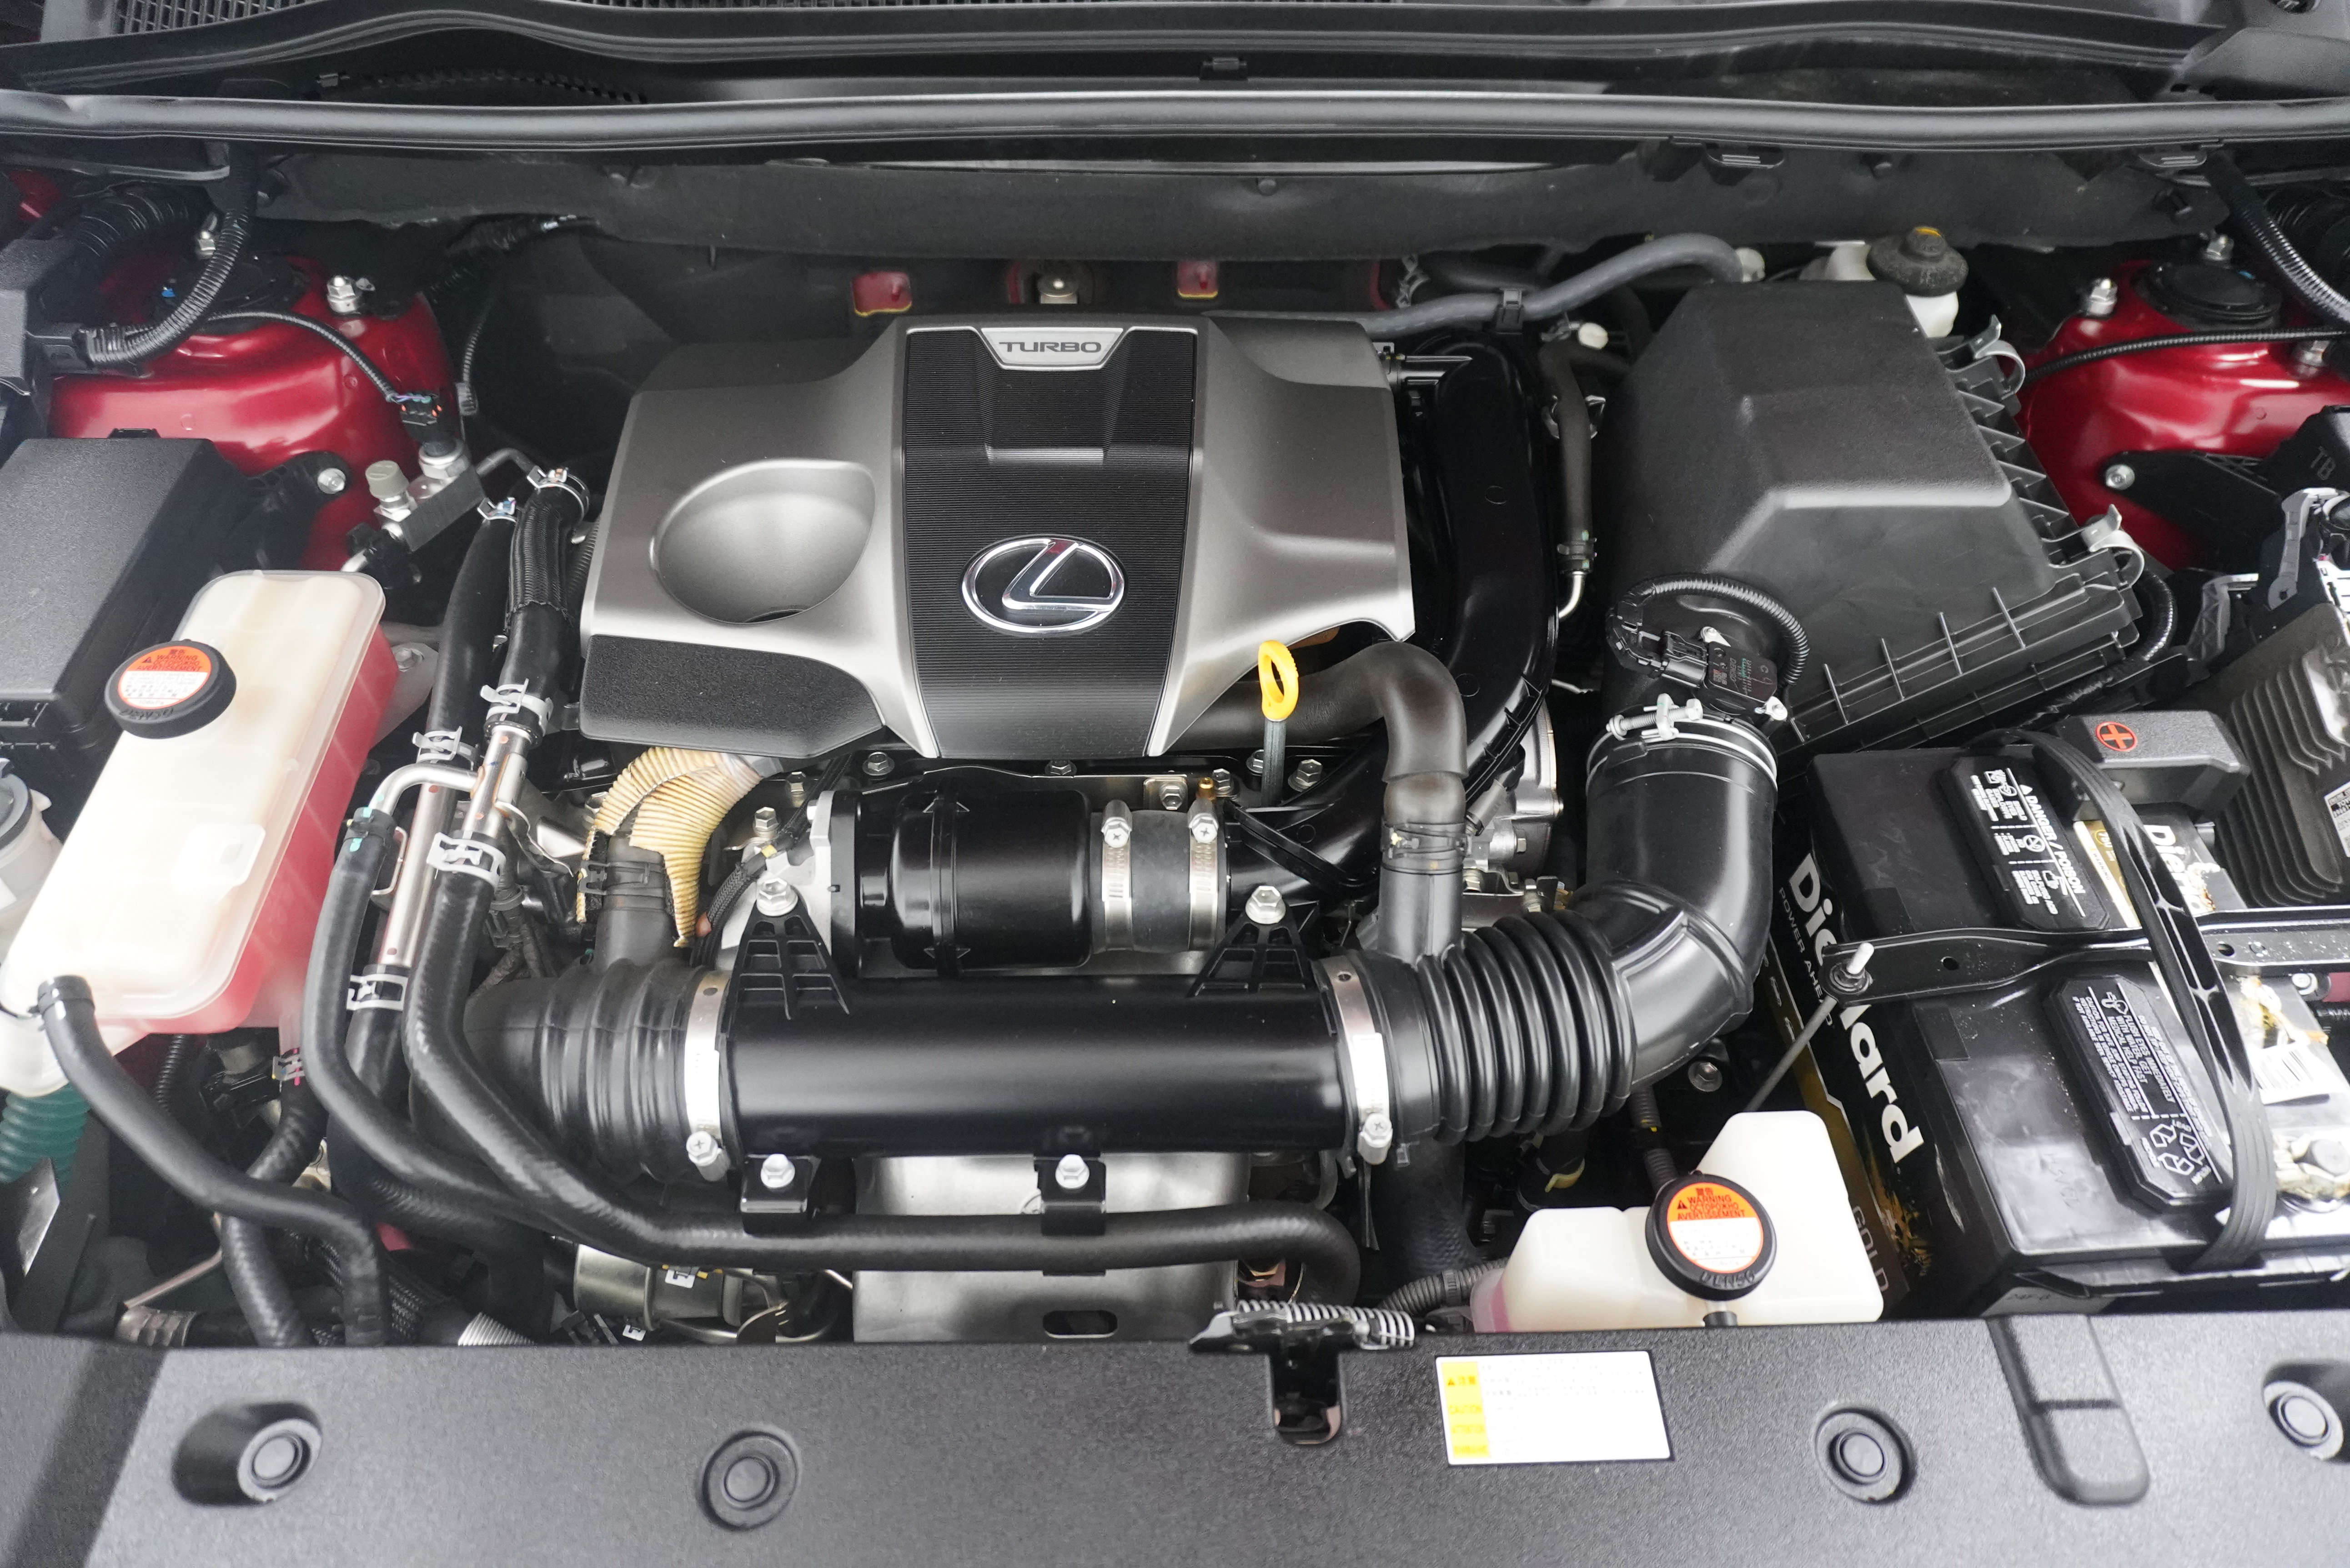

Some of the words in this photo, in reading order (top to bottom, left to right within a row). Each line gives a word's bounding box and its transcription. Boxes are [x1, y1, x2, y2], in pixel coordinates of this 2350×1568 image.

[999, 340, 1102, 354] TURBO
[1991, 788, 2013, 819] EXPLOSIVE
[2005, 801, 2019, 816] EYES
[2015, 839, 2026, 848] NO
[2025, 796, 2059, 841] DANGER
[2053, 850, 2087, 895] POISON
[2093, 853, 2111, 881] WARNING
[2029, 870, 2051, 900] SULFURIC
[2044, 899, 2058, 914] ACID
[1779, 887, 1805, 953] POWER
[1804, 960, 1833, 1026] AHED
[2075, 1003, 2085, 1014] NOT
[2101, 1042, 2116, 1064] VEHICLE
[2107, 1016, 2126, 1045] MEDICAL
[2122, 1047, 2137, 1064] HELP
[2132, 1066, 2148, 1083] FAST
[2116, 1016, 2130, 1033] WITH
[2139, 1061, 2152, 1075] GET
[2097, 1021, 2107, 1032] FOR
[2103, 1033, 2114, 1046] SAFE
[2110, 1048, 2122, 1062] JUMP
[2118, 1063, 2136, 1089] STARTING
[2132, 1090, 2148, 1112] FOLLOW
[2124, 1015, 2141, 1037] FLUSH
[2135, 1038, 2150, 1056] EYES
[2145, 1057, 2175, 1103] IMMEDIATELY
[2171, 1119, 2192, 1132] LEAD
[1687, 1195, 1732, 1204] WARNING
[1677, 1210, 1745, 1220] AVERTISSEMENT
[1448, 1404, 1483, 1415] CAUTION
